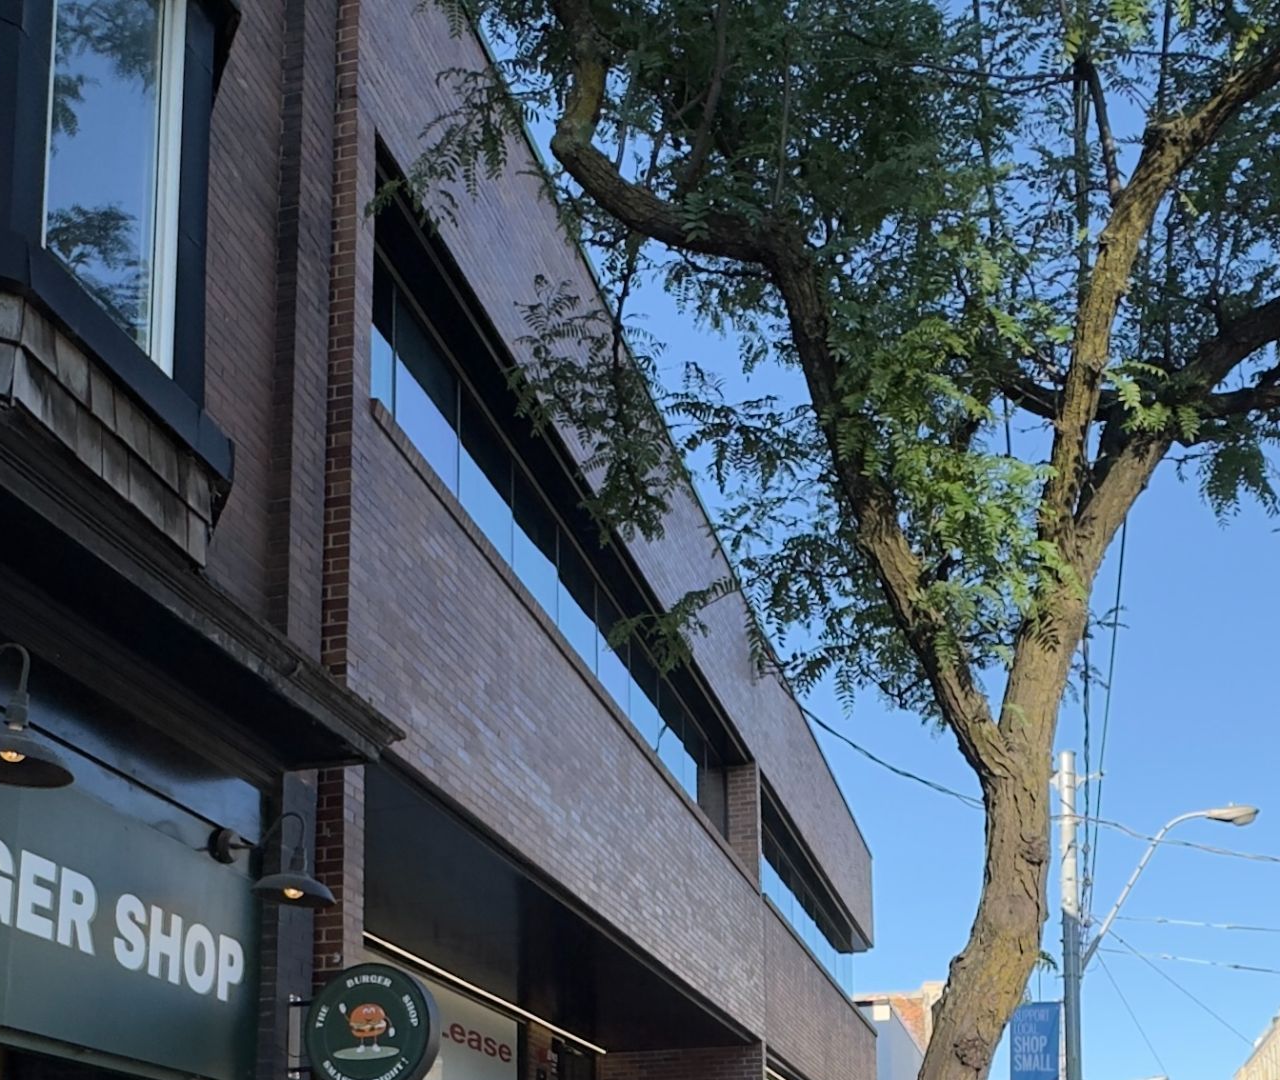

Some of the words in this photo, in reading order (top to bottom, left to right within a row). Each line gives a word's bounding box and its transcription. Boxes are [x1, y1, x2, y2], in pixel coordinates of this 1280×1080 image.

[113, 893, 245, 1002] SHOP
[315, 1005, 329, 1028] THE
[346, 975, 392, 988] BURGER
[402, 994, 419, 1027] SHOP
[442, 1022, 513, 1063] ease
[1014, 1035, 1048, 1054] SHOP
[1014, 1053, 1056, 1073] SMALL
